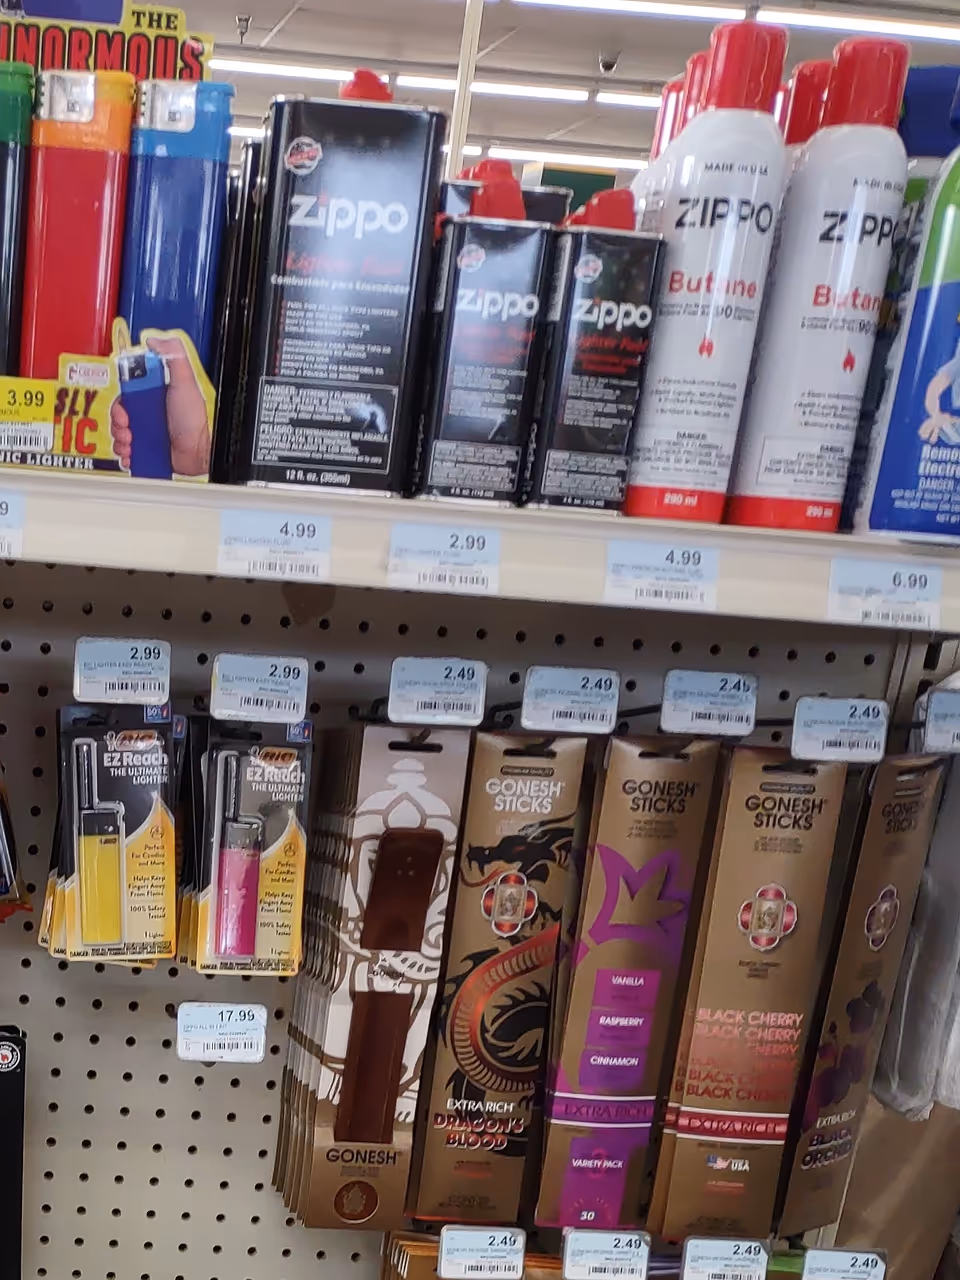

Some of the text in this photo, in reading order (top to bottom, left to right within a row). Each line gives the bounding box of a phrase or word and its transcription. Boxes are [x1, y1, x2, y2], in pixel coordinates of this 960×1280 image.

[132, 10, 178, 31] THE
[8, 390, 44, 407] 3.99
[27, 453, 93, 469] LIGHTER
[280, 521, 317, 539] 4.99
[450, 534, 486, 552] 2.99
[665, 550, 702, 566] 4.99
[892, 572, 928, 588] 6.99
[130, 647, 161, 660] 2.99
[580, 677, 612, 691] 2.49
[849, 705, 880, 719] 2.49
[103, 752, 168, 767] EZ Reach
[110, 767, 168, 777] THE ULTIMATE
[132, 775, 168, 785] LIGHTER
[485, 779, 561, 797] GONESH
[494, 797, 553, 813] STICKS
[744, 795, 824, 815] GONESH
[753, 813, 813, 831] STICKS
[611, 975, 644, 987] VANILLA
[217, 1010, 255, 1023] 17.99
[599, 1016, 645, 1027] RASPBERRY
[697, 1007, 804, 1027] BLACK CHERRY
[590, 1055, 638, 1067] CINNAMON
[447, 1098, 514, 1113] EXTRA RICH
[326, 1149, 397, 1165] GONESH
[732, 1244, 761, 1256] 2.49
[850, 1256, 878, 1269] 2.49
